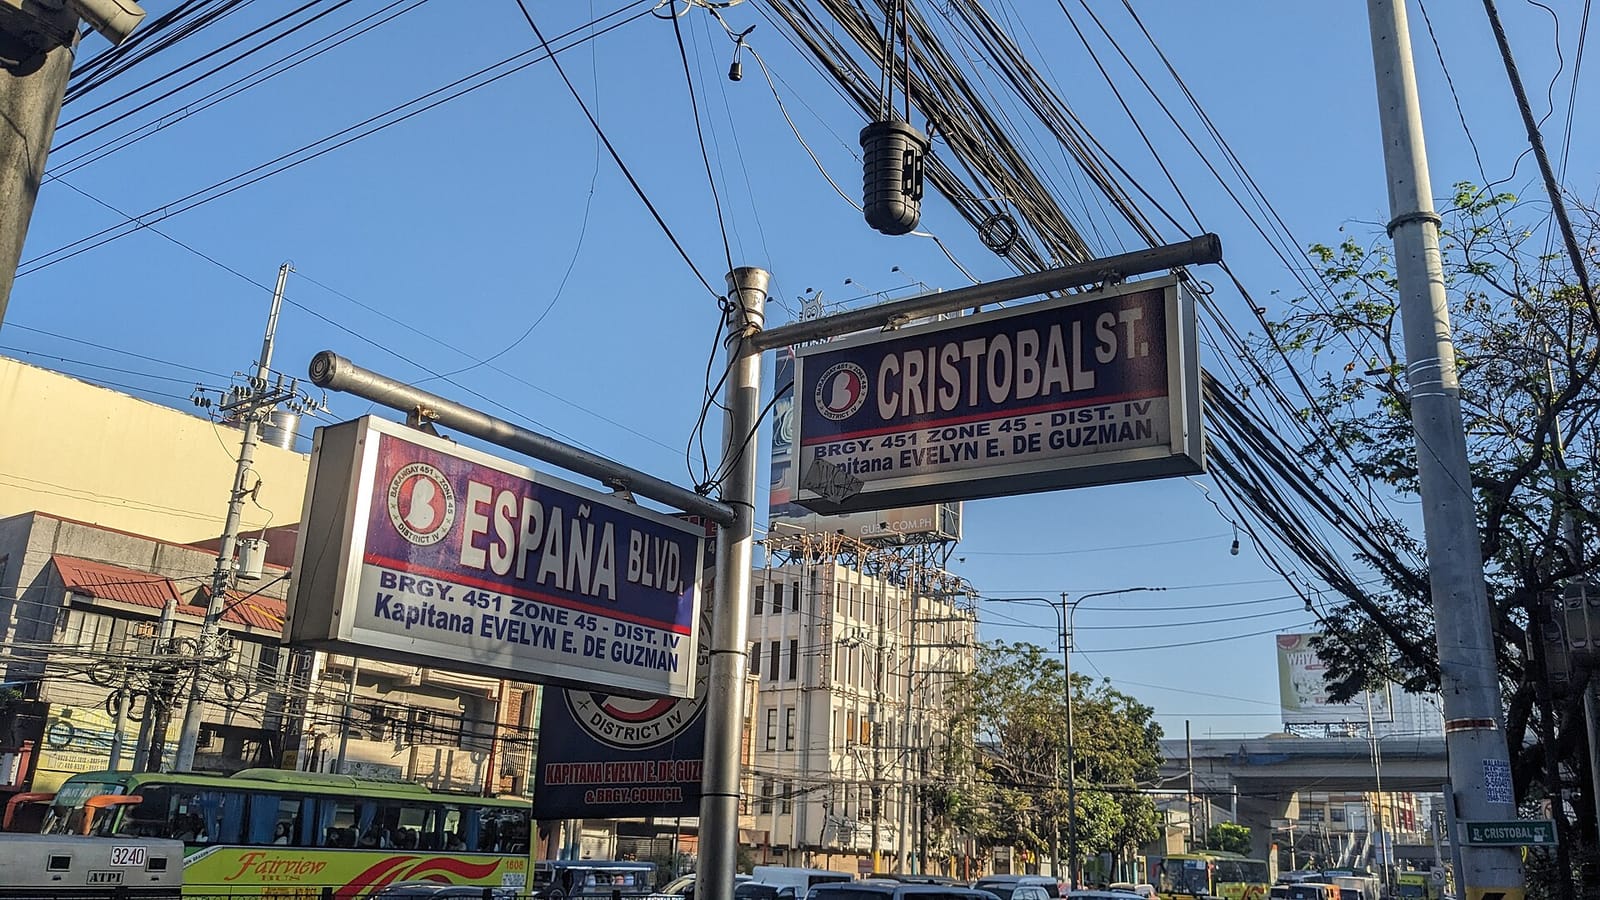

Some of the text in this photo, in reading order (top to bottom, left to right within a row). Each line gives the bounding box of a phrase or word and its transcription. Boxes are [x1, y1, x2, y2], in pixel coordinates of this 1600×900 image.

[876, 306, 1151, 421] CRISTOBAL ST.
[813, 438, 875, 460] BRGY.
[880, 431, 919, 450] 451
[927, 421, 991, 443] ZONE
[998, 417, 1028, 434] 45
[1050, 405, 1116, 427] DIST.
[1123, 400, 1153, 416] IV
[899, 440, 980, 470] EVELYN
[986, 438, 1005, 458] E.
[1012, 433, 1041, 454] DE
[1048, 418, 1153, 450] GUZMAN
[390, 465, 454, 515] BARANGAY 451 ZONE 45
[397, 523, 440, 543] DISTRICT IV
[459, 479, 686, 601] ESPAÑA BLVD.
[379, 570, 454, 603] BRGY.
[462, 588, 502, 612] 451
[510, 600, 568, 627] ZONE
[574, 613, 598, 632] 45
[613, 622, 658, 646] DIST.
[661, 632, 681, 649] IV
[373, 591, 680, 674] Kapitana EVELYN E. DE GUZMAN
[590, 709, 683, 742] DISTRICT IV
[544, 763, 603, 785] KAPITANA
[603, 760, 647, 784] EVELYN
[646, 759, 658, 783] E.
[658, 759, 675, 782] DE
[584, 786, 683, 804] & BRGY. COUNCIL
[1484, 827, 1533, 839] CRISTOBAL
[112, 847, 145, 865] 3240
[224, 850, 328, 881] Fairview
[89, 872, 122, 883] ATPI
